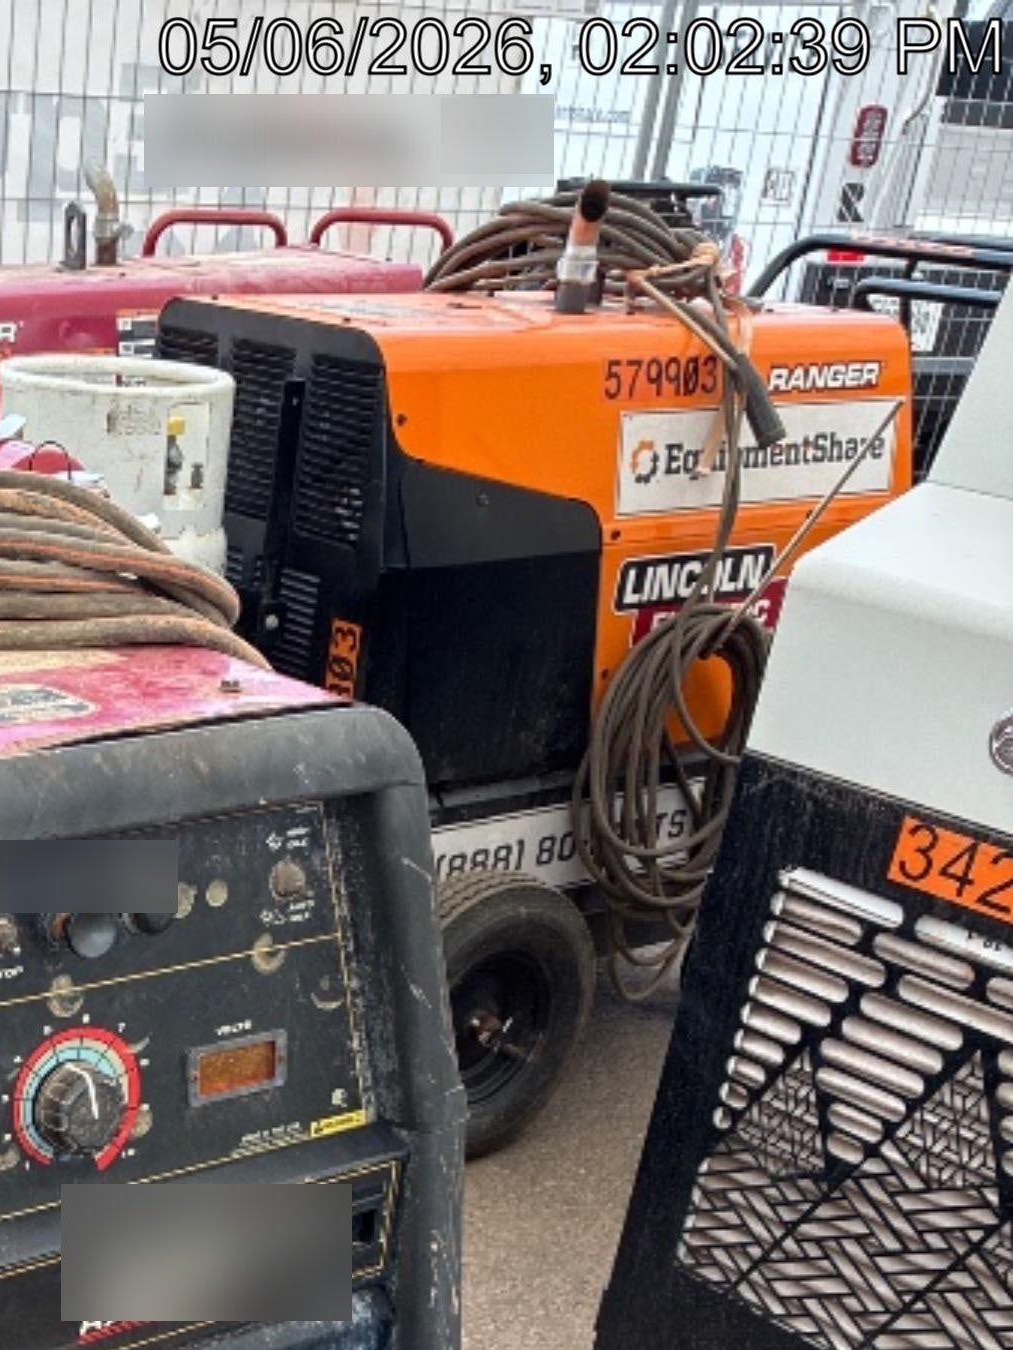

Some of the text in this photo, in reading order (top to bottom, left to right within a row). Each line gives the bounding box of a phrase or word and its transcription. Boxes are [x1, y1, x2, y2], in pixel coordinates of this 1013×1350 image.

[604, 356, 718, 399] 579903
[768, 361, 881, 391] RANGER
[664, 431, 886, 481] EqimentShare
